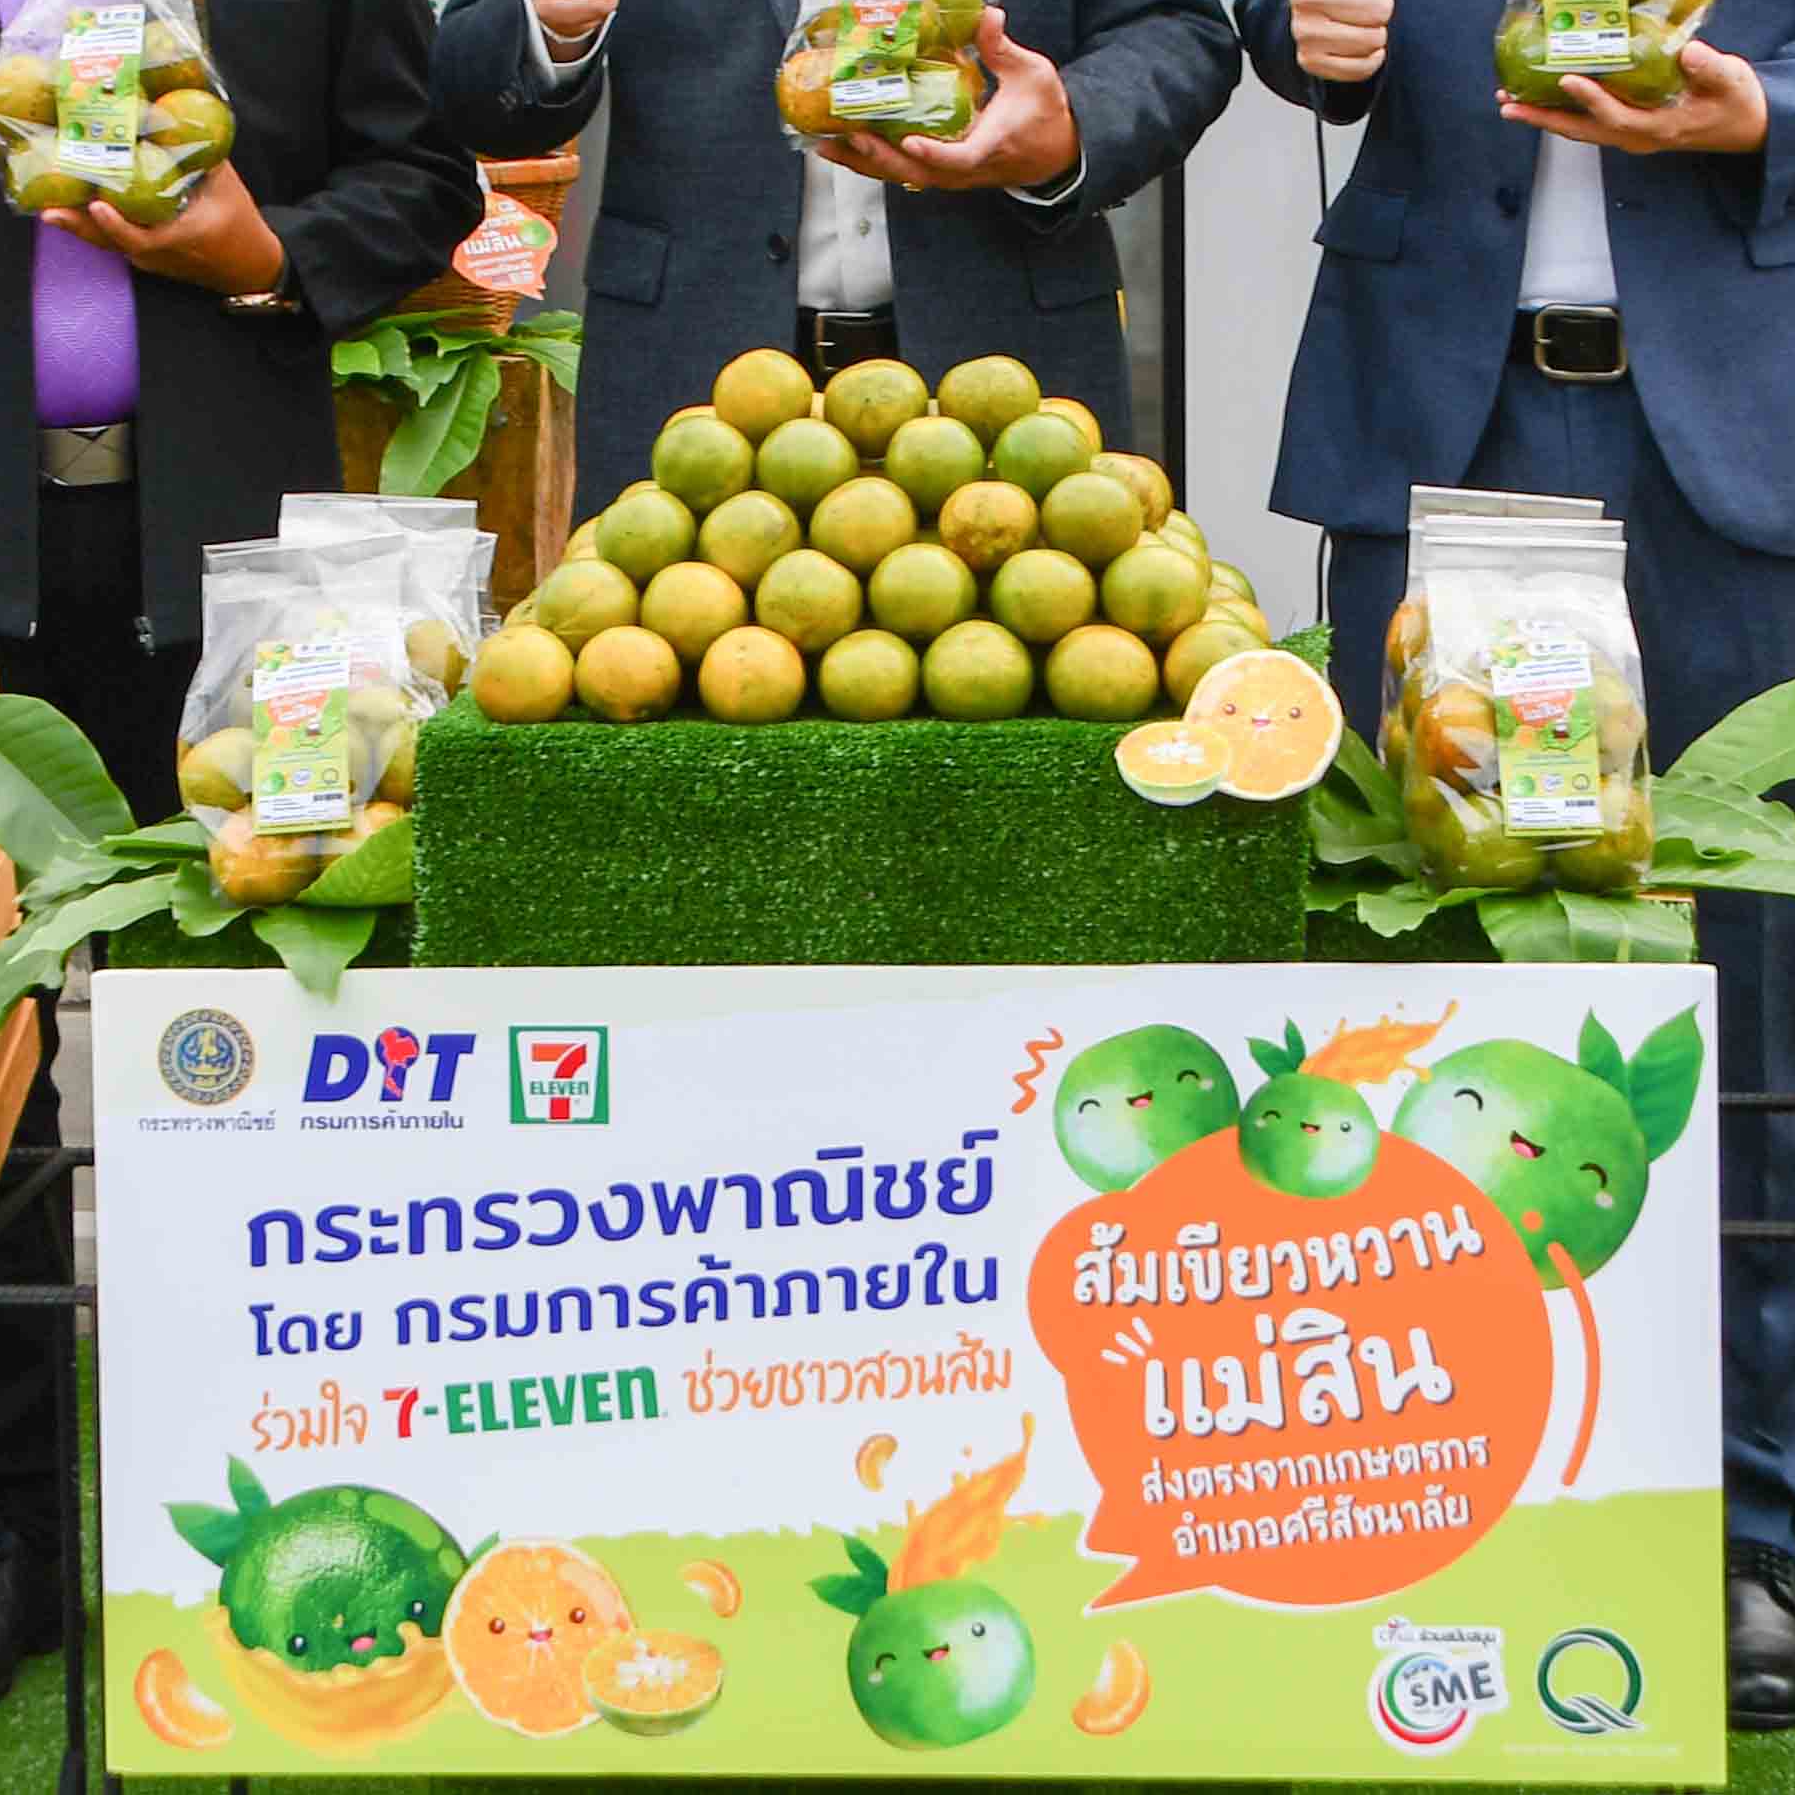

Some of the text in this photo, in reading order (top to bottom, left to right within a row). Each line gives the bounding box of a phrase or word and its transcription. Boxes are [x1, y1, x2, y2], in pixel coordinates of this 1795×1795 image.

[301, 1110, 464, 1131] กรมการค้าภายใน
[248, 1129, 999, 1268] กระทรวงพาณิชย์
[248, 1241, 999, 1356] โดย กรมการค้าภายใน
[1072, 1204, 1484, 1308] ส้มเขียวหวาน
[252, 1380, 369, 1453] ร่วมใจ
[682, 1332, 1012, 1416] ช่วยชาวสวนส้ม
[1143, 1307, 1455, 1441] แม่สิน
[1140, 1430, 1491, 1507] ส่งตรงจากเกษตรกร
[1172, 1489, 1473, 1560] อำเภอศรีสัชนาลัย
[1410, 1660, 1497, 1709] SME
